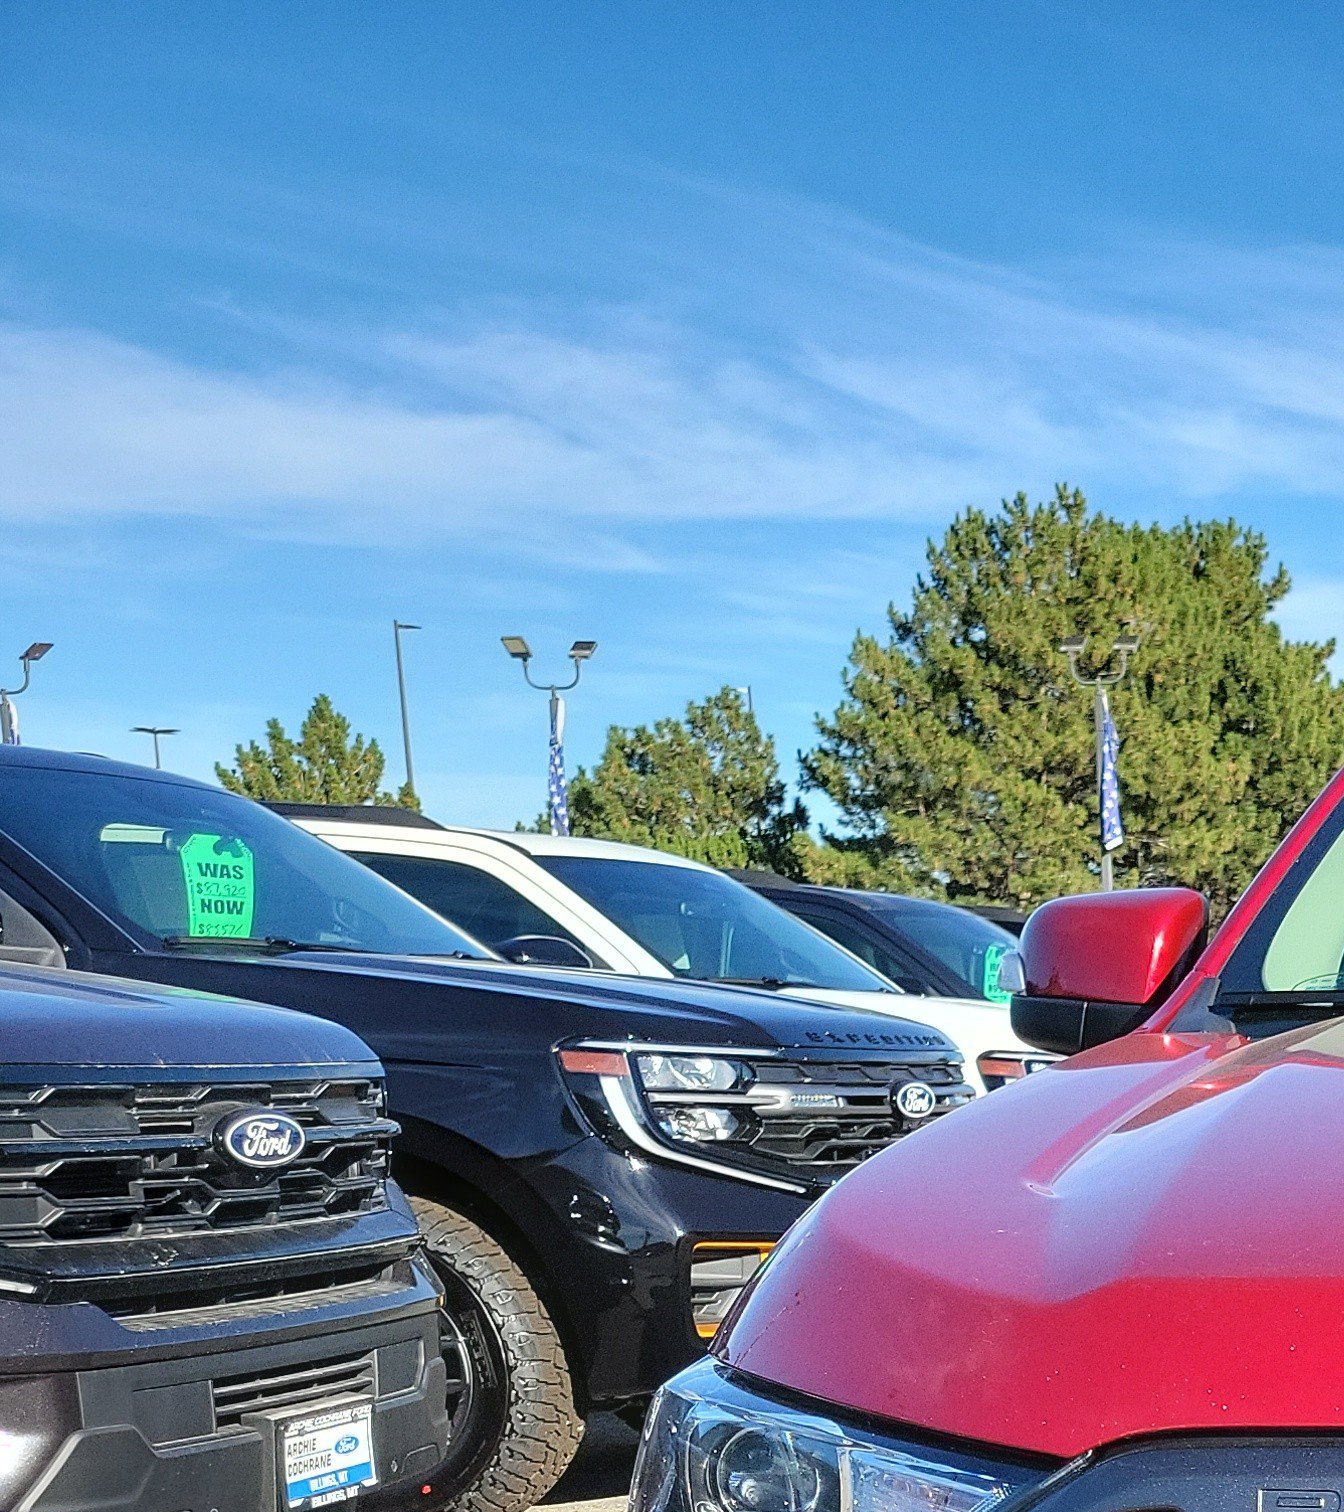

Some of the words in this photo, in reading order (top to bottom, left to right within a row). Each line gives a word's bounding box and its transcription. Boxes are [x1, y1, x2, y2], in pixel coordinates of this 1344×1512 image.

[197, 863, 244, 880] WAS
[200, 899, 244, 915] NOW
[244, 1121, 291, 1157] Ford
[287, 1438, 317, 1458] ARCHIE
[288, 1453, 332, 1477] COCHRANE
